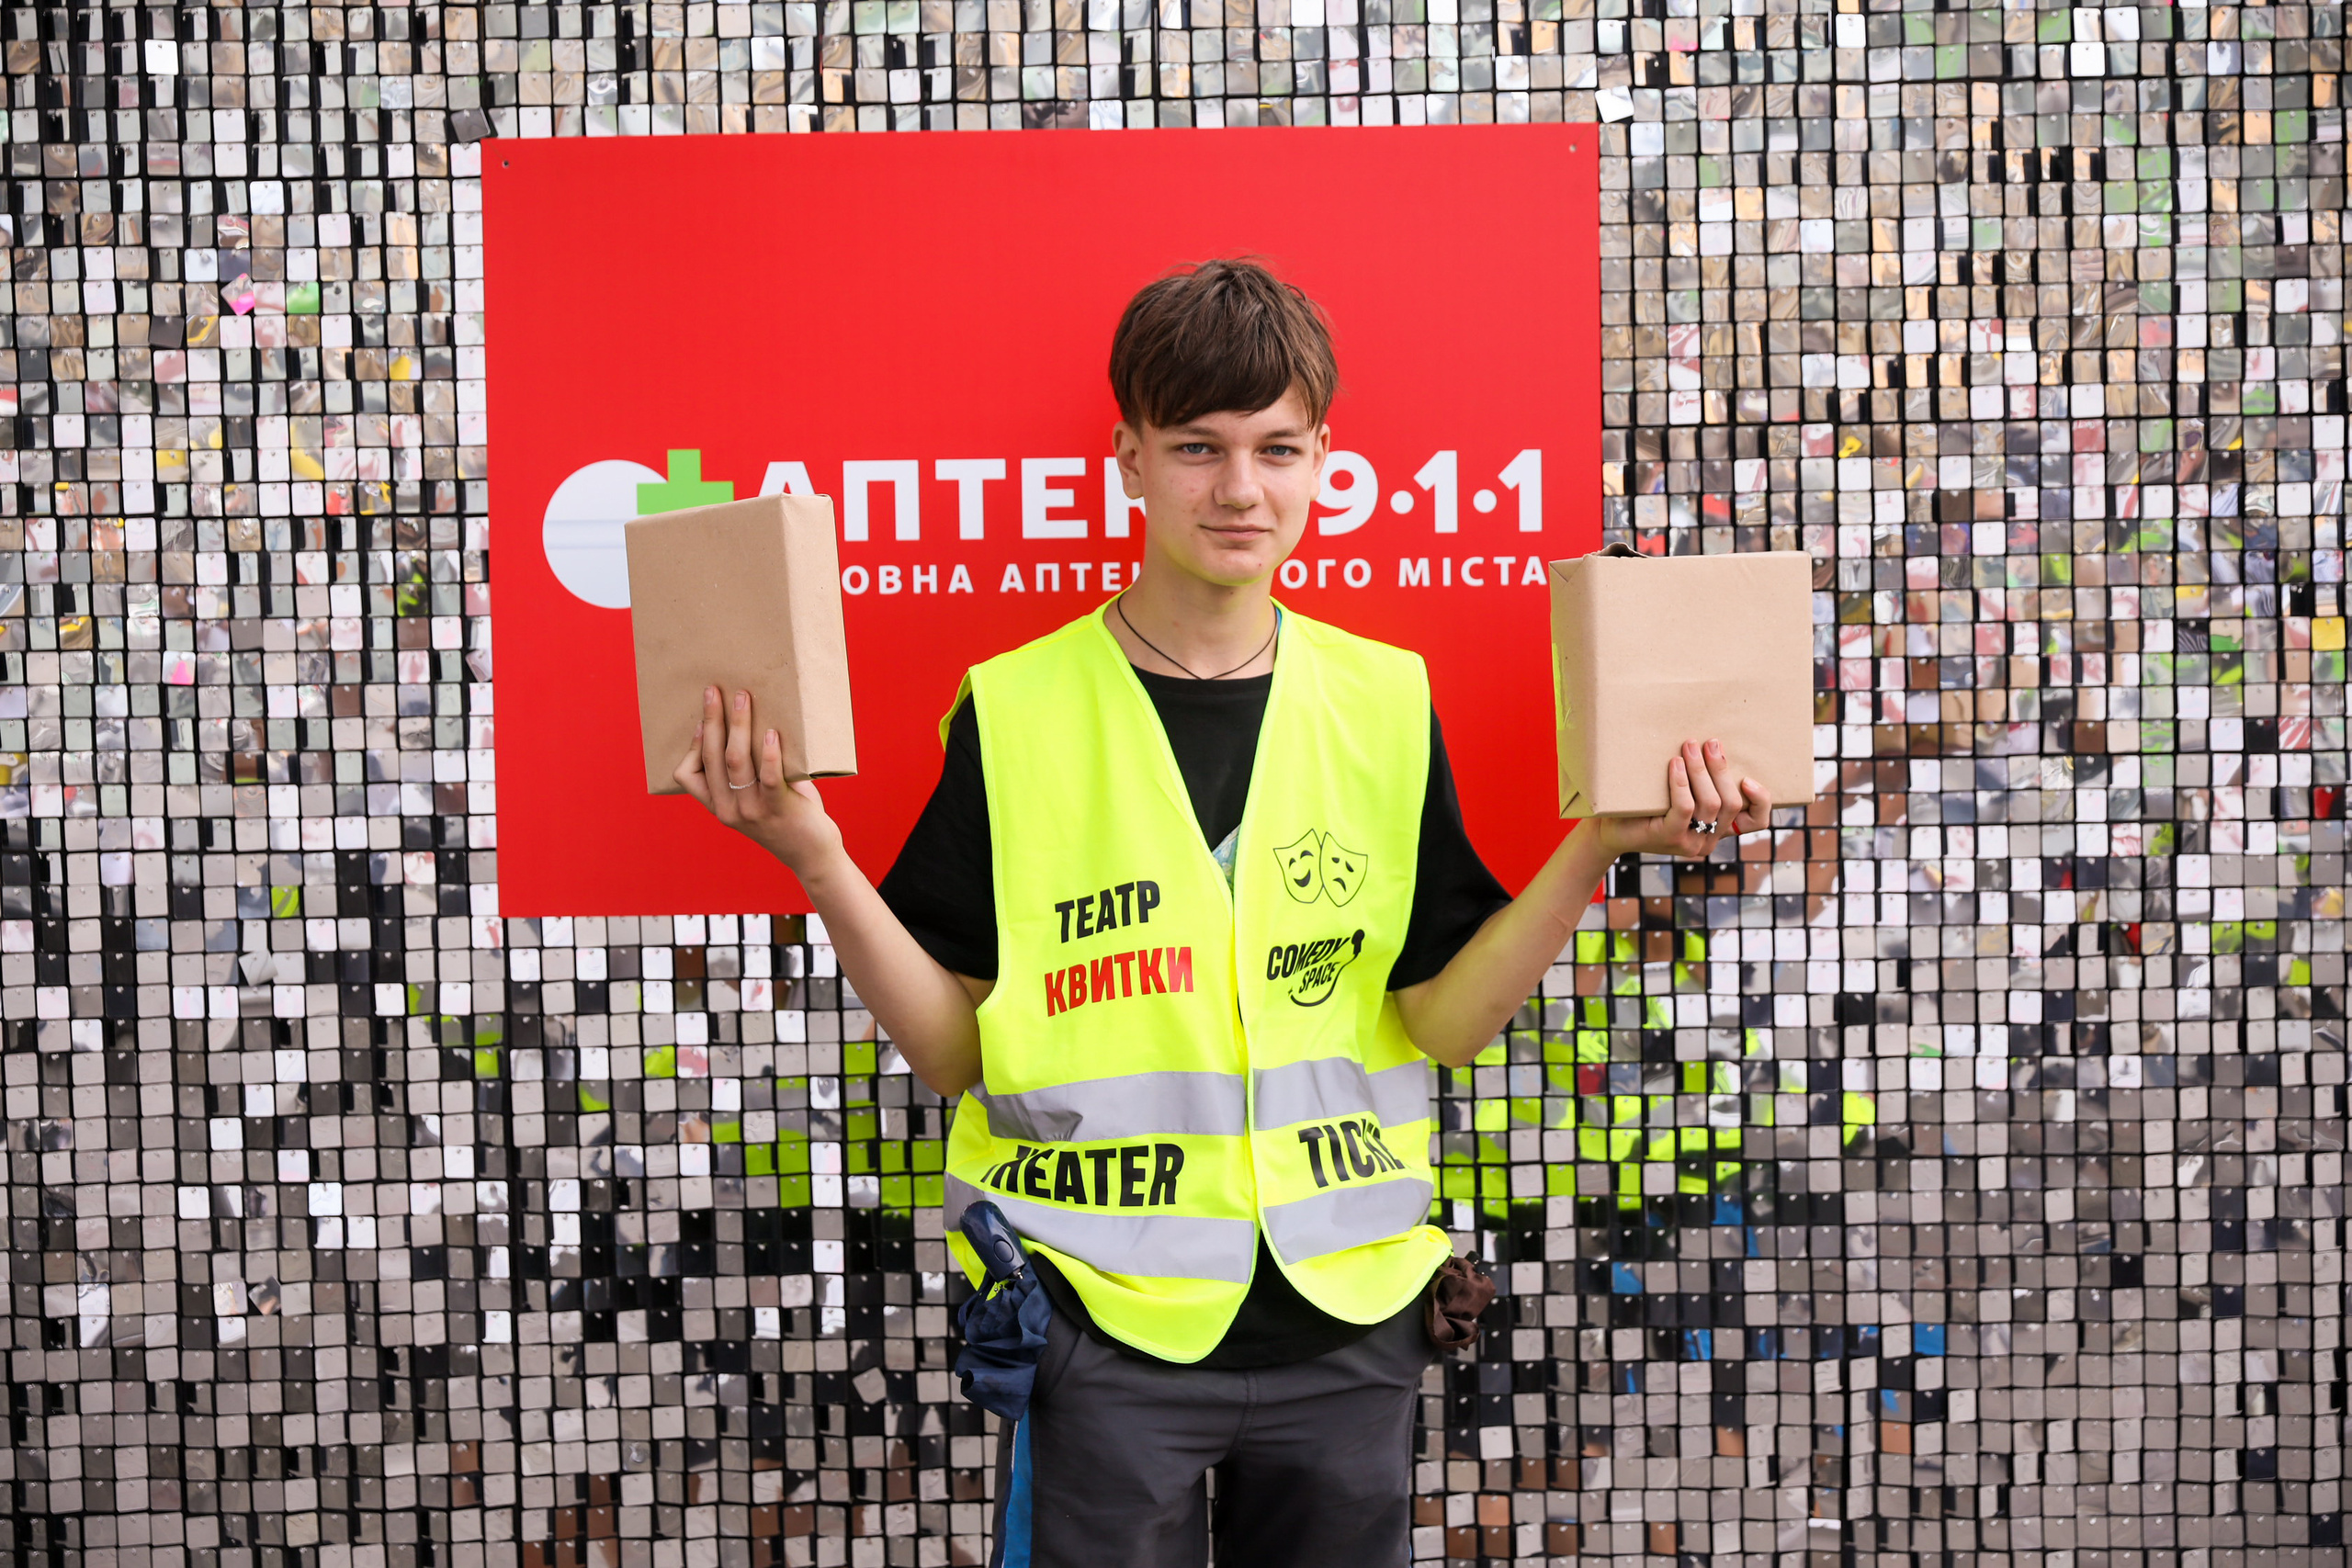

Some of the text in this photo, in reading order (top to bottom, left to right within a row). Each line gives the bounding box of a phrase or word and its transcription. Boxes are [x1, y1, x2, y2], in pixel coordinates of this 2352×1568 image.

[842, 556, 1548, 594] ОВНА АПТЕ ОГО МІСТА
[1054, 880, 1160, 943] ТЕАТР
[1266, 936, 1351, 980] COMEDY
[1298, 961, 1341, 994] SPACE
[1044, 946, 1193, 1018] КВИТКИ
